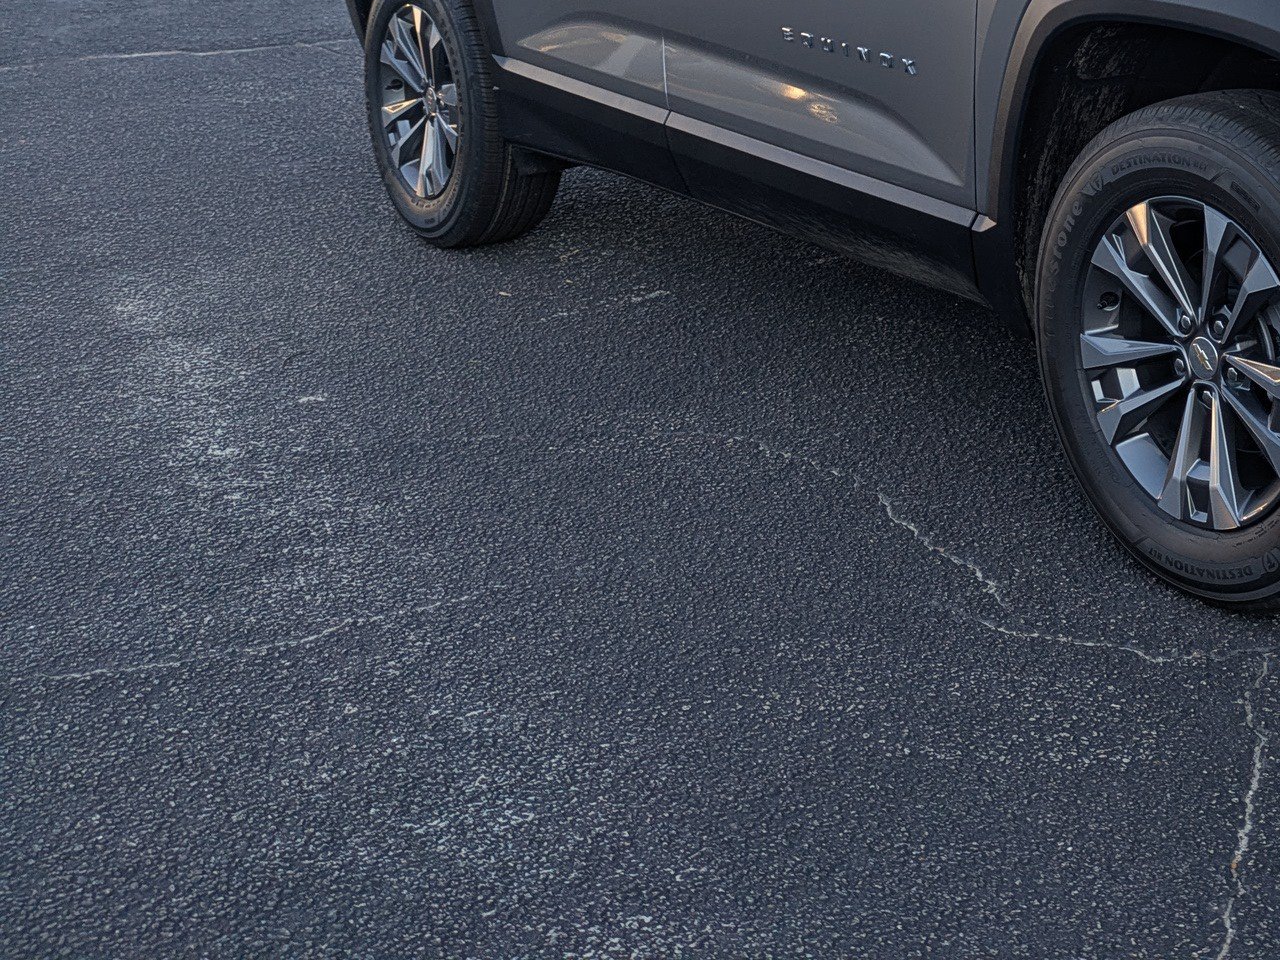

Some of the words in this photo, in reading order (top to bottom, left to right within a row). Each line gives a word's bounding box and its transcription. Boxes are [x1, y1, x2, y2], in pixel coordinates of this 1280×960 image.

[781, 26, 917, 76] EQUINOX
[1111, 151, 1191, 176] DESTINATION
[1164, 554, 1254, 580] DESTINATION
